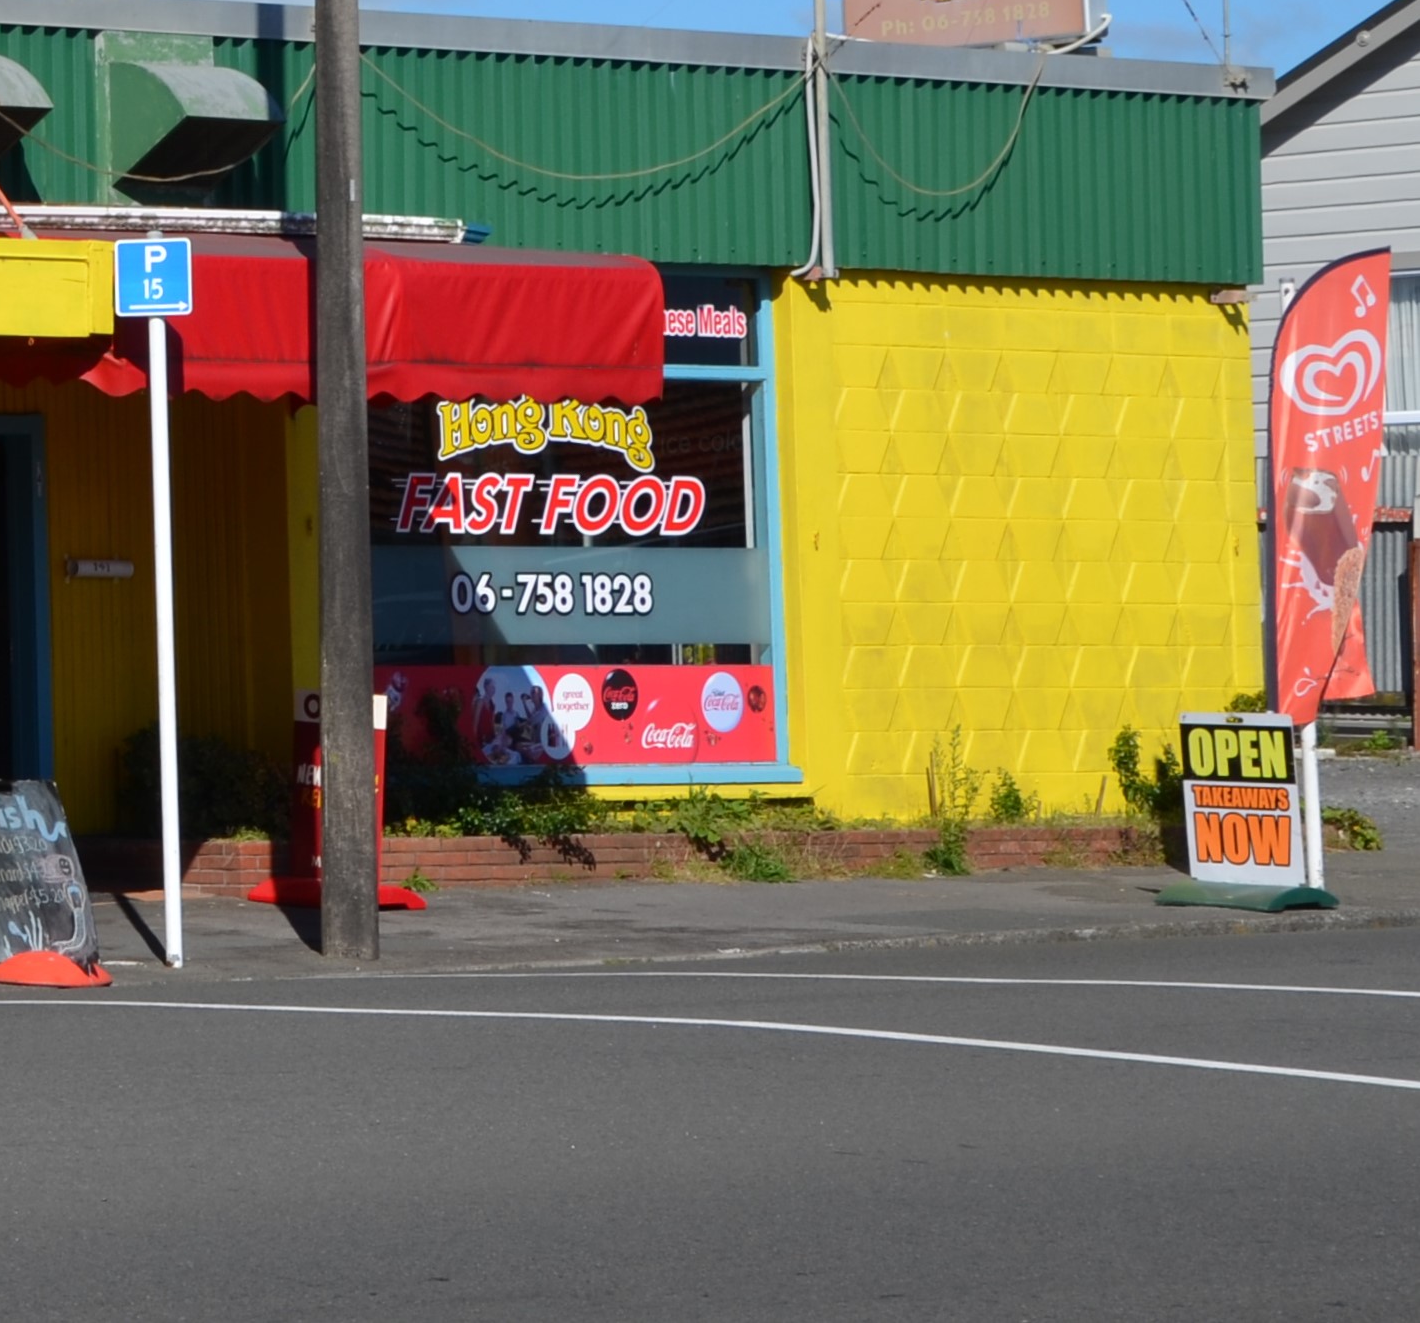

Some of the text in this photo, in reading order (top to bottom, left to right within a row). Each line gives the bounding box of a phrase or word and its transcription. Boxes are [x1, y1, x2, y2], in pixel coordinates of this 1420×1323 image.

[881, 19, 915, 37] Ph:
[1002, 1, 1051, 22] 1828
[144, 245, 167, 273] P
[143, 277, 164, 300] 15
[697, 303, 747, 339] Meals
[436, 393, 655, 473] Hong Kong
[1304, 410, 1379, 453] STREETS
[396, 472, 706, 536] FAST FOOD
[579, 571, 654, 616] 1828
[557, 701, 590, 712] together
[562, 690, 584, 701] great
[611, 701, 629, 710] zero
[1187, 727, 1288, 779] OPEN
[1191, 784, 1290, 812] TAKEAWAYS
[1193, 811, 1291, 867] NOW
